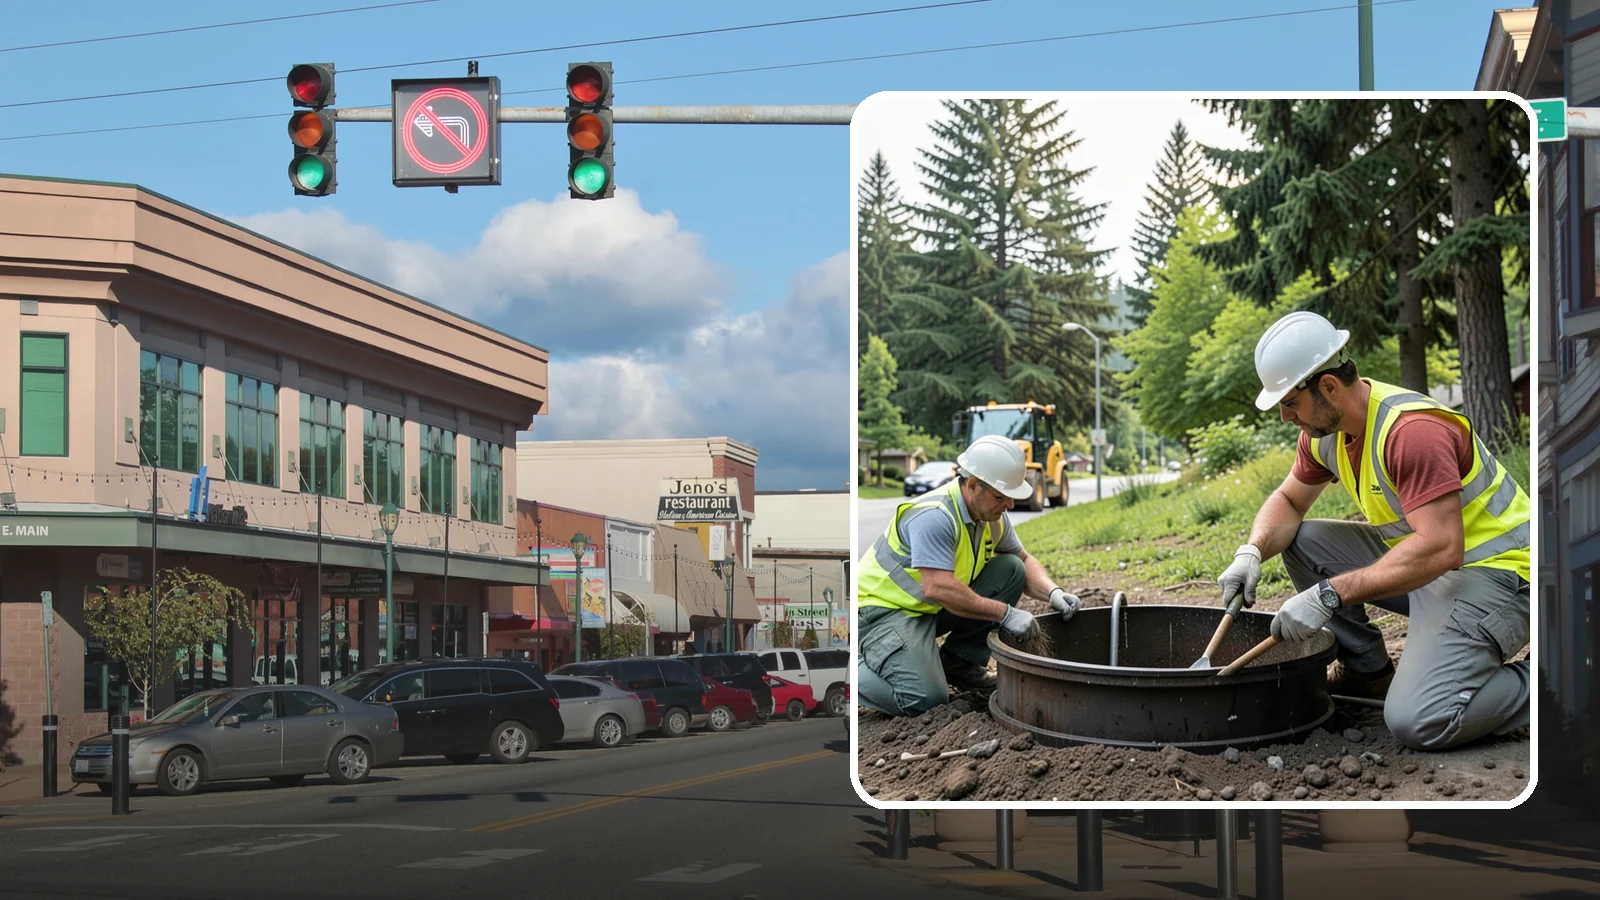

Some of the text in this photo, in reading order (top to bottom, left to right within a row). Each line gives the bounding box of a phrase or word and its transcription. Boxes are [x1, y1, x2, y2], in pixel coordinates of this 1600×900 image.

[670, 480, 727, 494] Jeno's
[665, 496, 731, 509] restaurant
[659, 510, 681, 519] Italian
[685, 510, 715, 519] American
[715, 509, 738, 519] Cuisine
[2, 525, 49, 536] E. MAIN
[797, 608, 829, 617] Street
